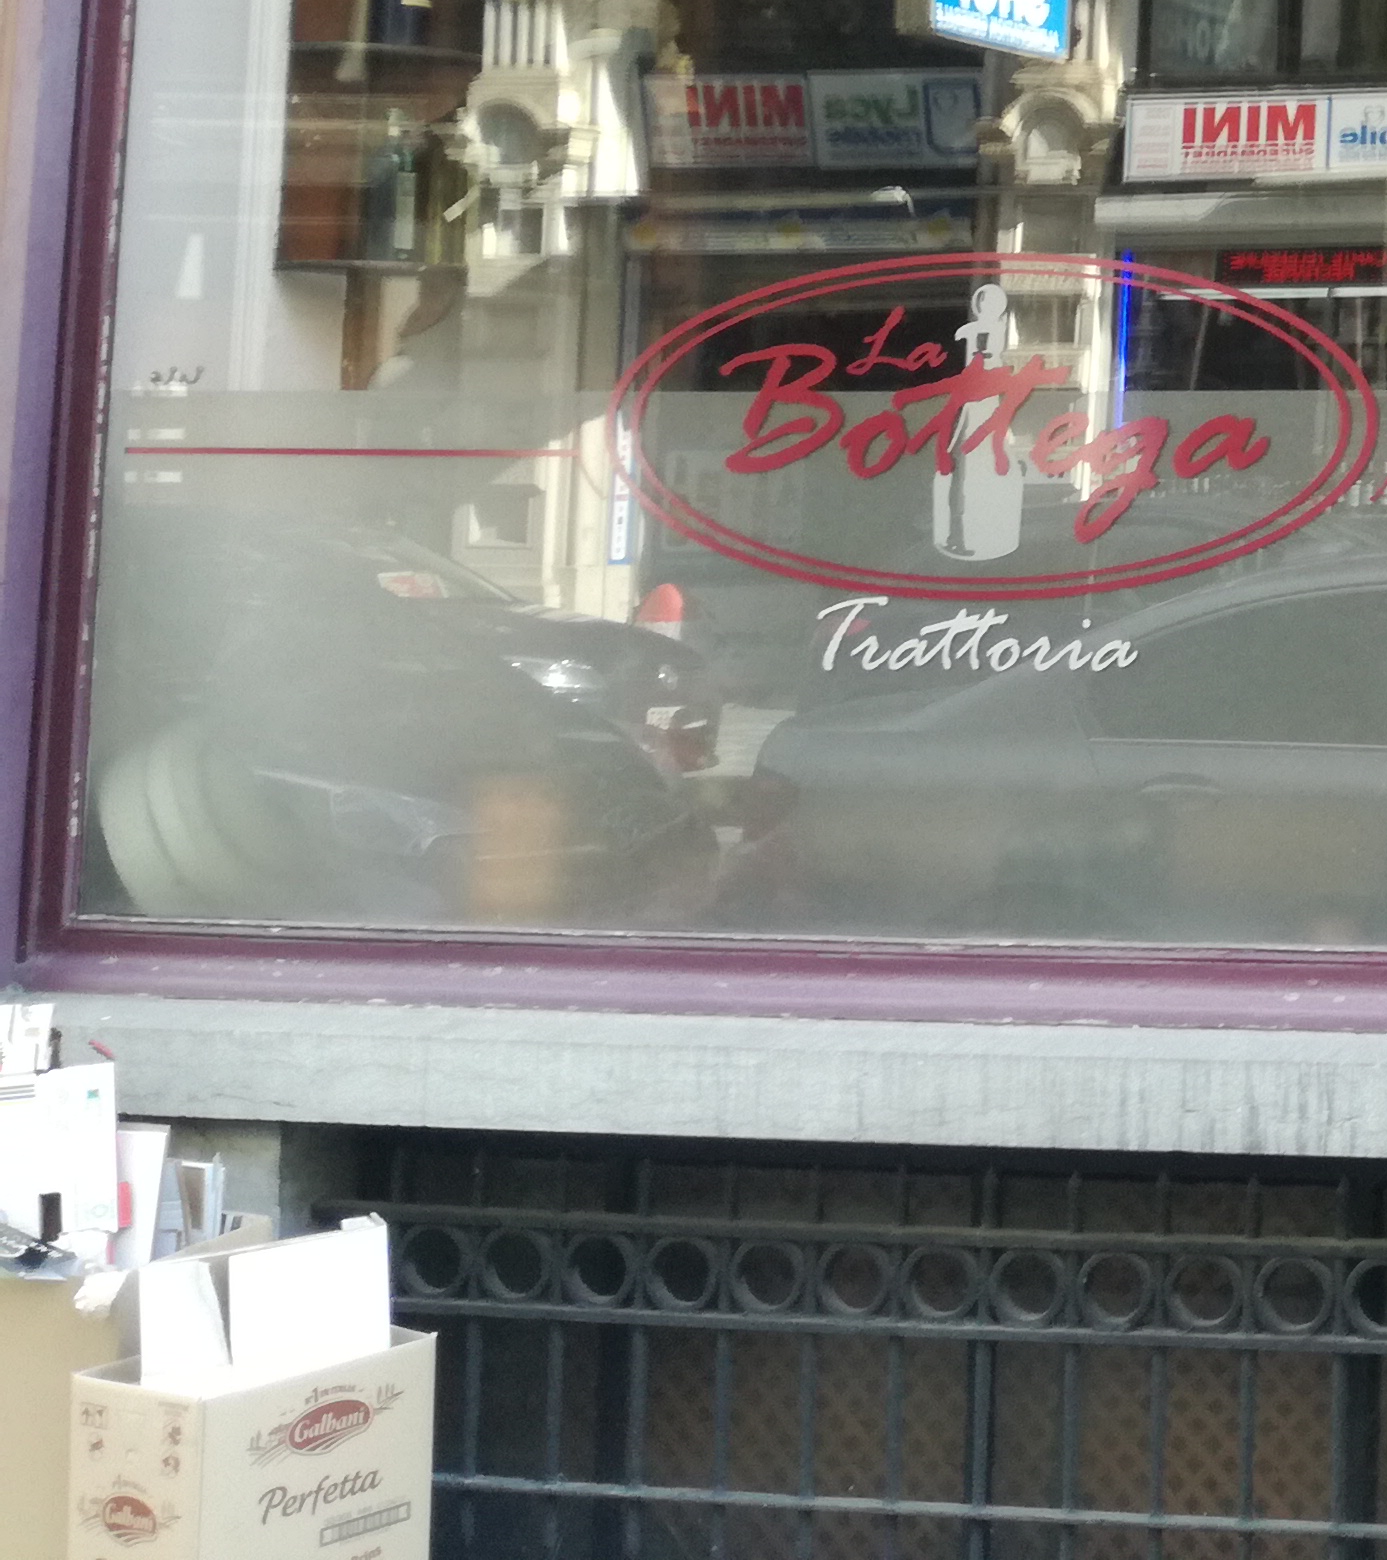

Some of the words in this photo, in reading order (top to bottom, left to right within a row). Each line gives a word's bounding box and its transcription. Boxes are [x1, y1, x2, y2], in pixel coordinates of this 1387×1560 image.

[847, 306, 948, 376] La
[720, 342, 1270, 544] Bottega
[815, 595, 1139, 674] Trattoria
[294, 1407, 366, 1443] Galbani
[258, 1468, 384, 1526] Perfetta
